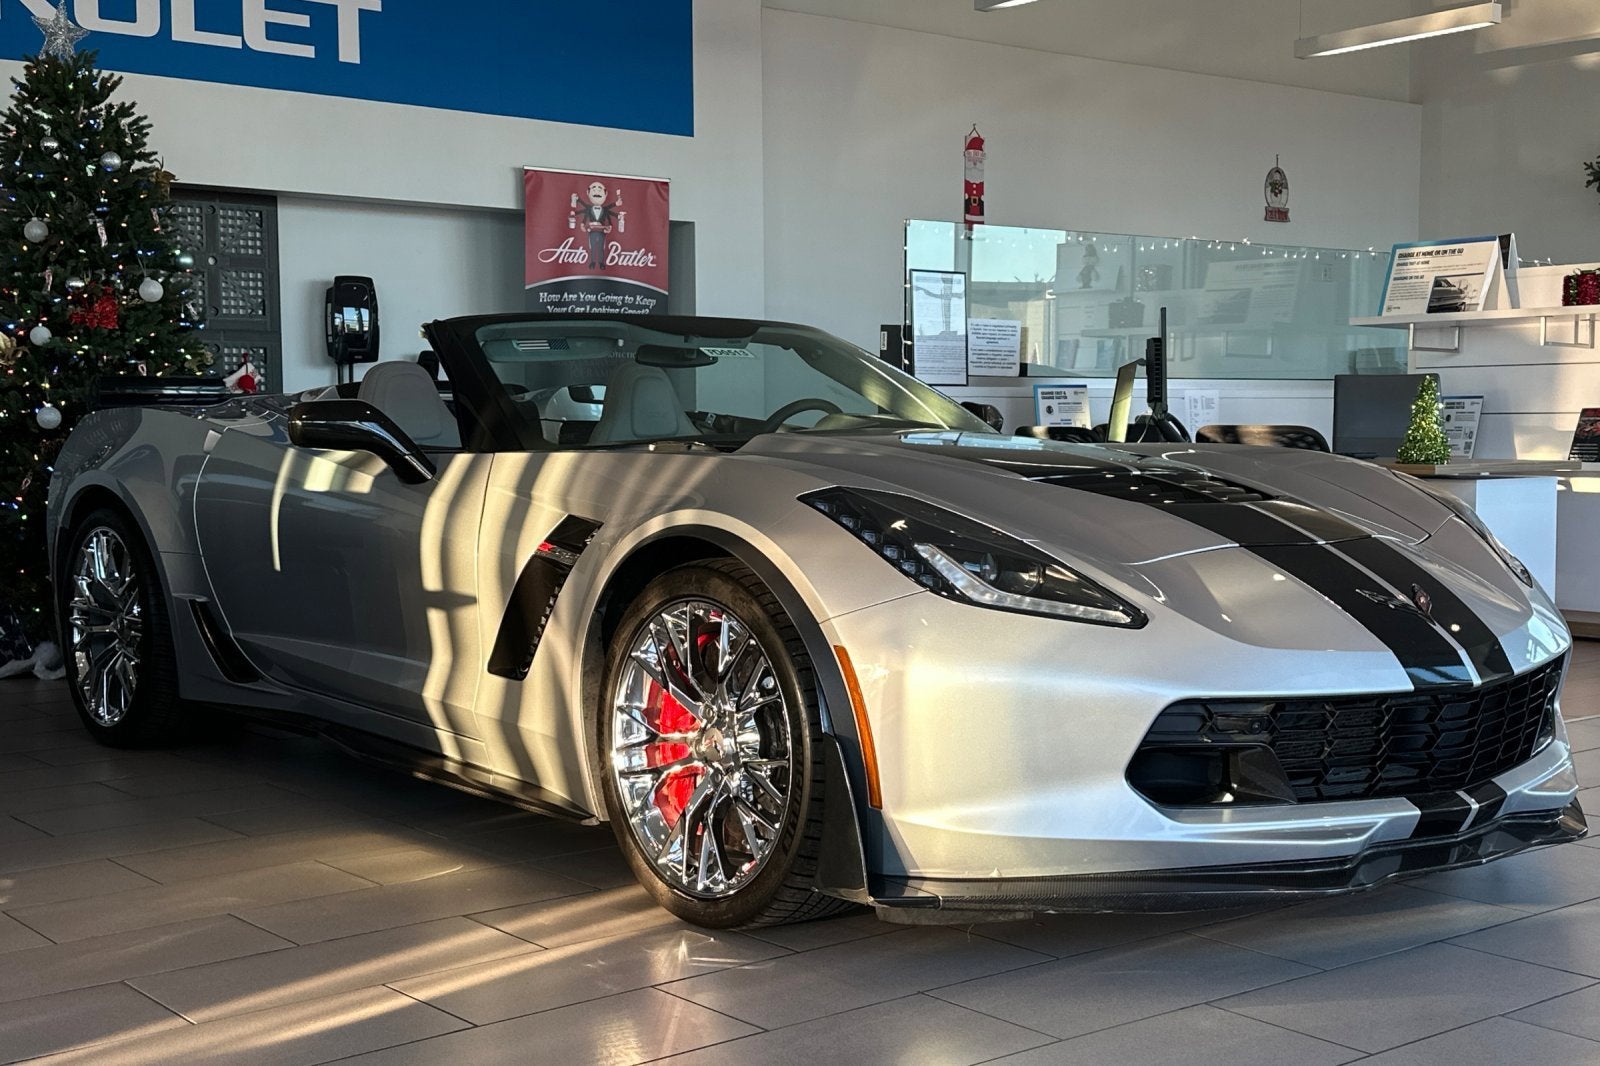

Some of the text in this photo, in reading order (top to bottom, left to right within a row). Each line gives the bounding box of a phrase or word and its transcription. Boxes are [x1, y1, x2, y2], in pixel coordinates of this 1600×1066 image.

[538, 237, 656, 267] Auto Butler
[539, 292, 656, 308] How Are You Going to Keep
